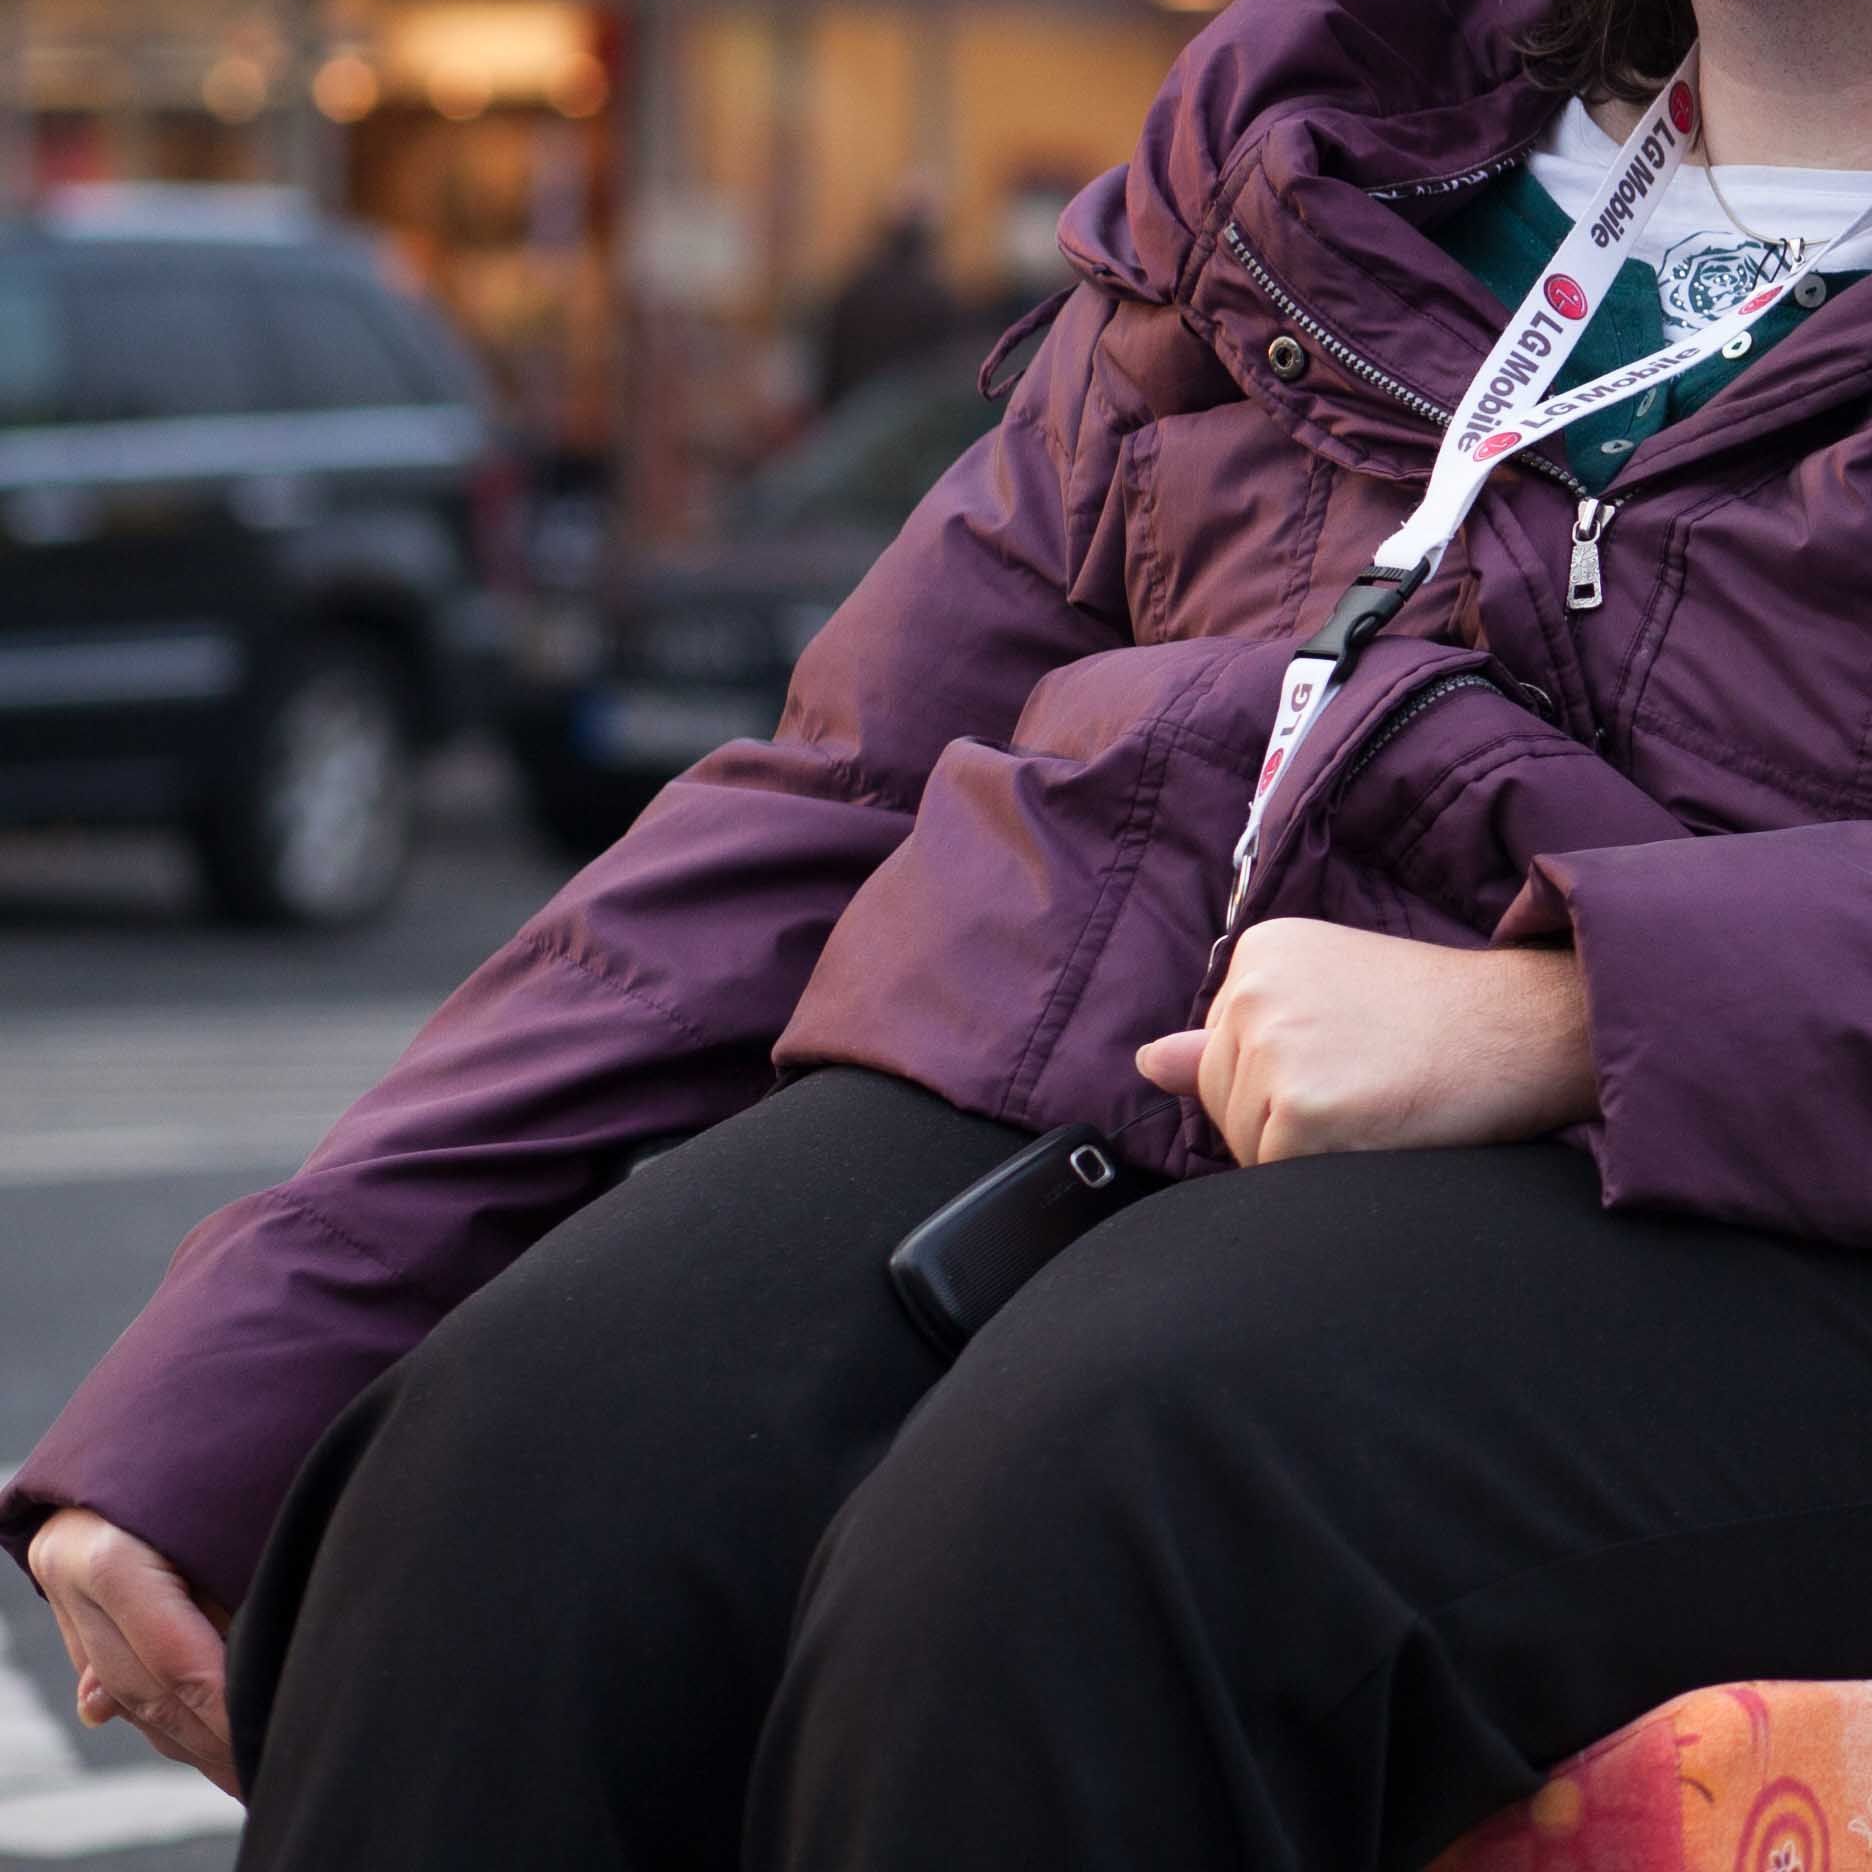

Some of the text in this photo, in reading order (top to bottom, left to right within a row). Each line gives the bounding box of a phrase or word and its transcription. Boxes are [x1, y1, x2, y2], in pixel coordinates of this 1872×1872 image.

[1591, 117, 1676, 248] LG Mobile
[1458, 310, 1564, 453] LG Mobile
[1520, 347, 1700, 429] LG Mobile
[1280, 683, 1313, 736] LG
